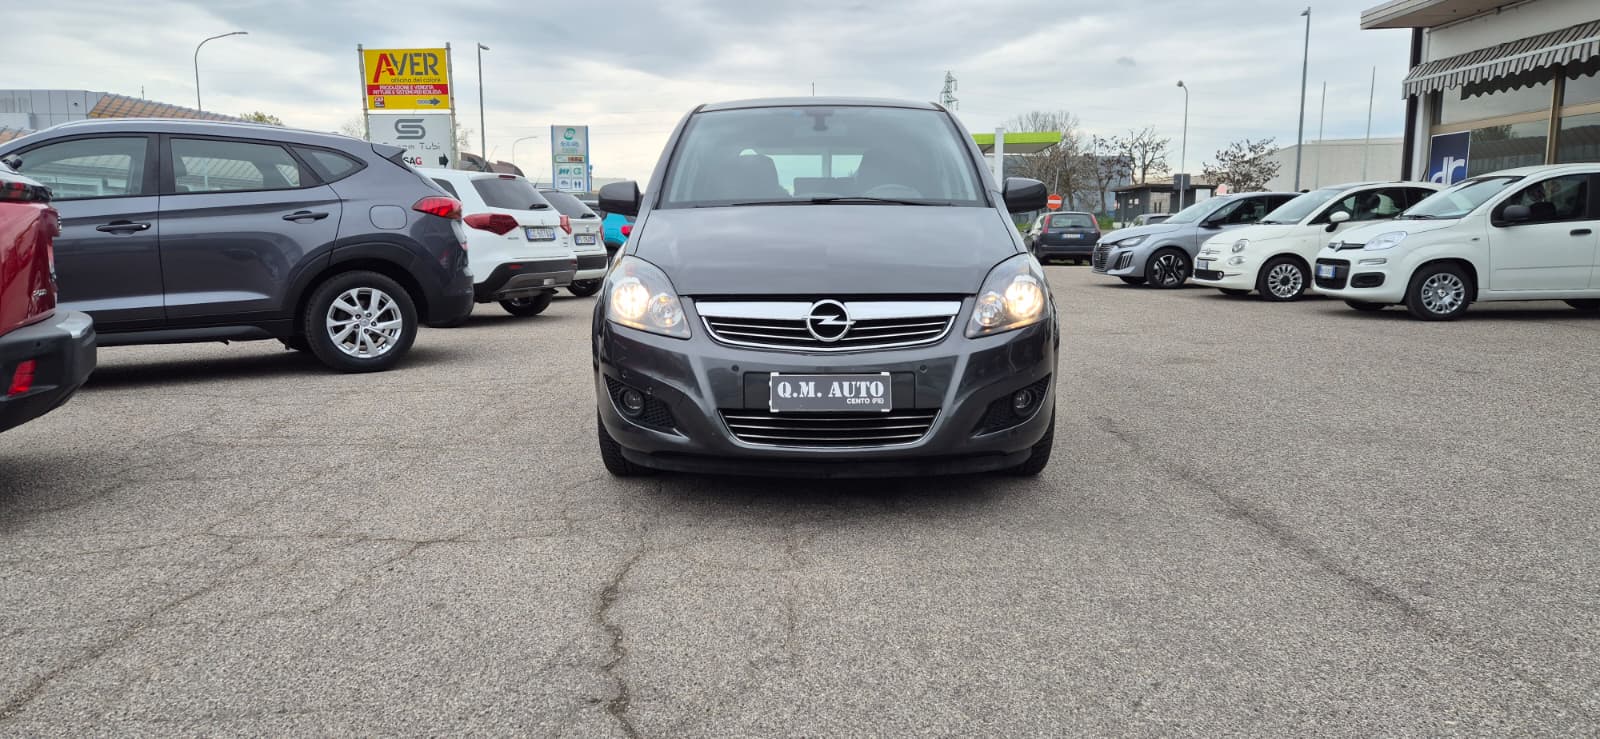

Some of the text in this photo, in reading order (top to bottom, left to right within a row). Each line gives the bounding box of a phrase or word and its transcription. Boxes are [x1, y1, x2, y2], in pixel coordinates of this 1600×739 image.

[373, 53, 439, 83] AVER
[419, 142, 441, 150] Tubi
[777, 381, 884, 398] Q.M. AUTO
